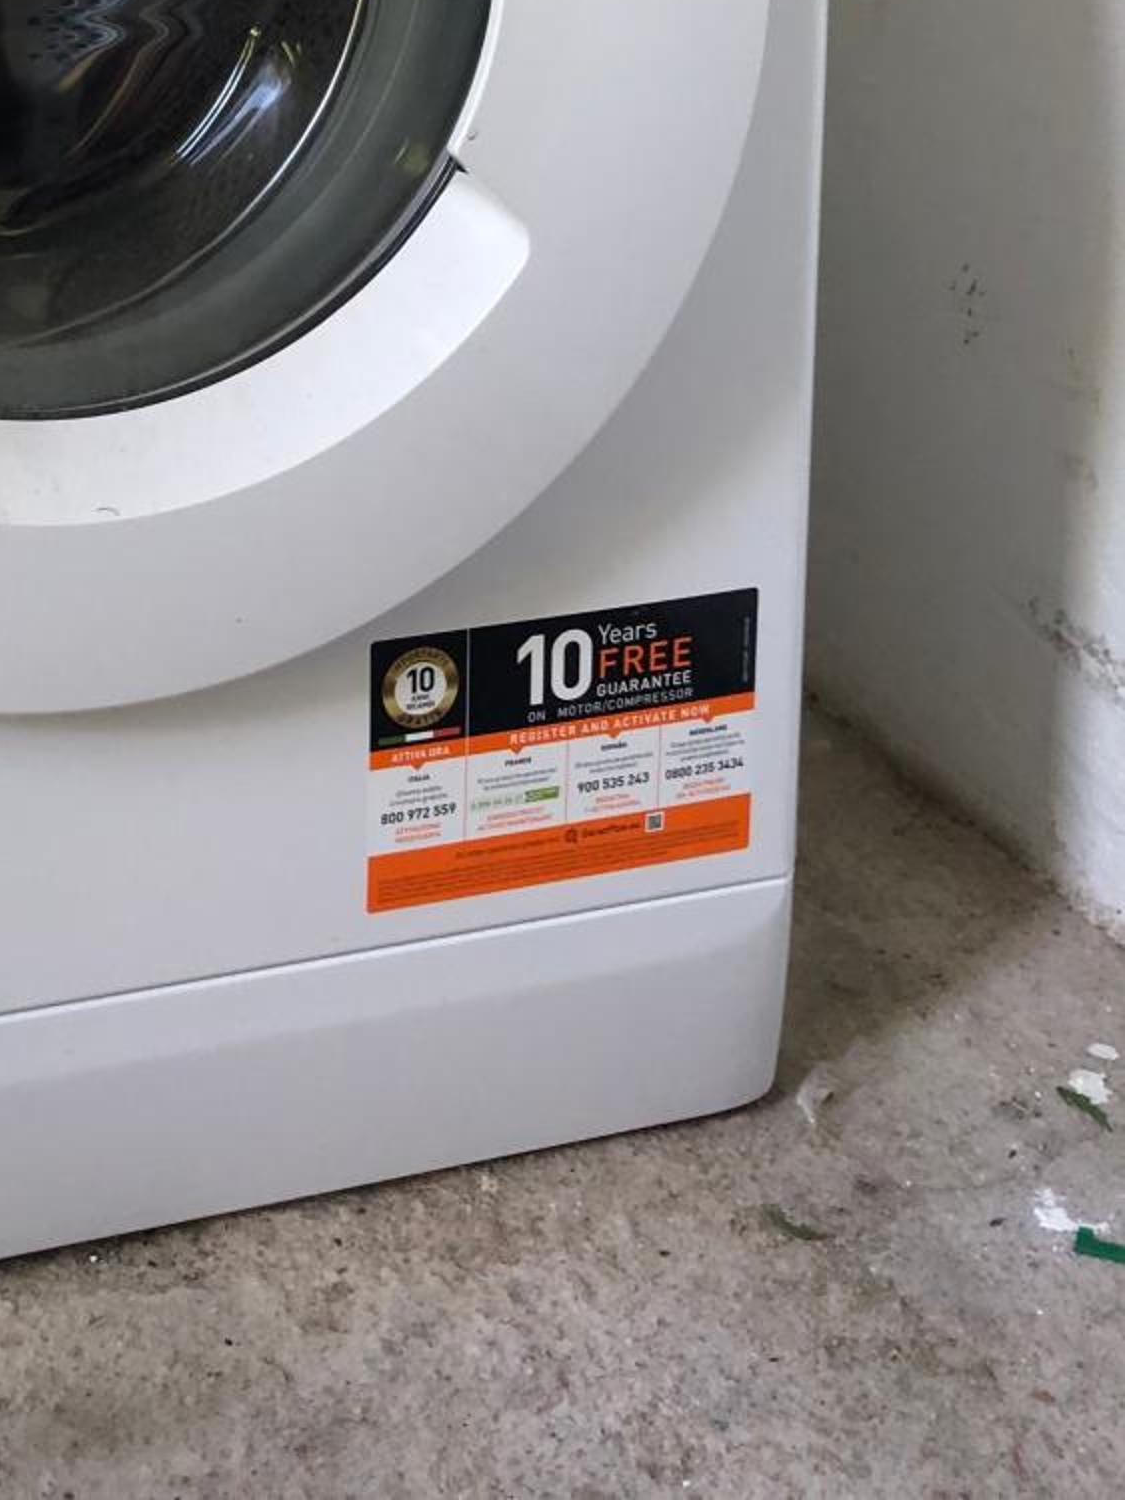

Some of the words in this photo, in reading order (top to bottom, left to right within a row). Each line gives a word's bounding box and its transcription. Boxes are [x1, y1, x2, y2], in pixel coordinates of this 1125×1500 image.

[597, 622, 658, 644] Years
[516, 629, 594, 706] 10
[600, 635, 693, 678] FREE
[407, 666, 435, 694] 10
[596, 670, 693, 698] GUARANTEE
[527, 710, 546, 723] ON
[557, 687, 694, 718] MOTOR/COMPRESSOR
[510, 720, 575, 744] REGISTER
[581, 716, 609, 731] AND
[613, 709, 677, 729] ACTIVATE
[681, 703, 710, 718] NOW
[694, 762, 715, 776] 235
[717, 756, 744, 772] 3434
[577, 780, 600, 794] 900
[602, 775, 625, 790] 535
[627, 771, 650, 785] 243
[380, 811, 404, 825] 800
[407, 806, 430, 820] 972
[433, 802, 457, 817] 559
